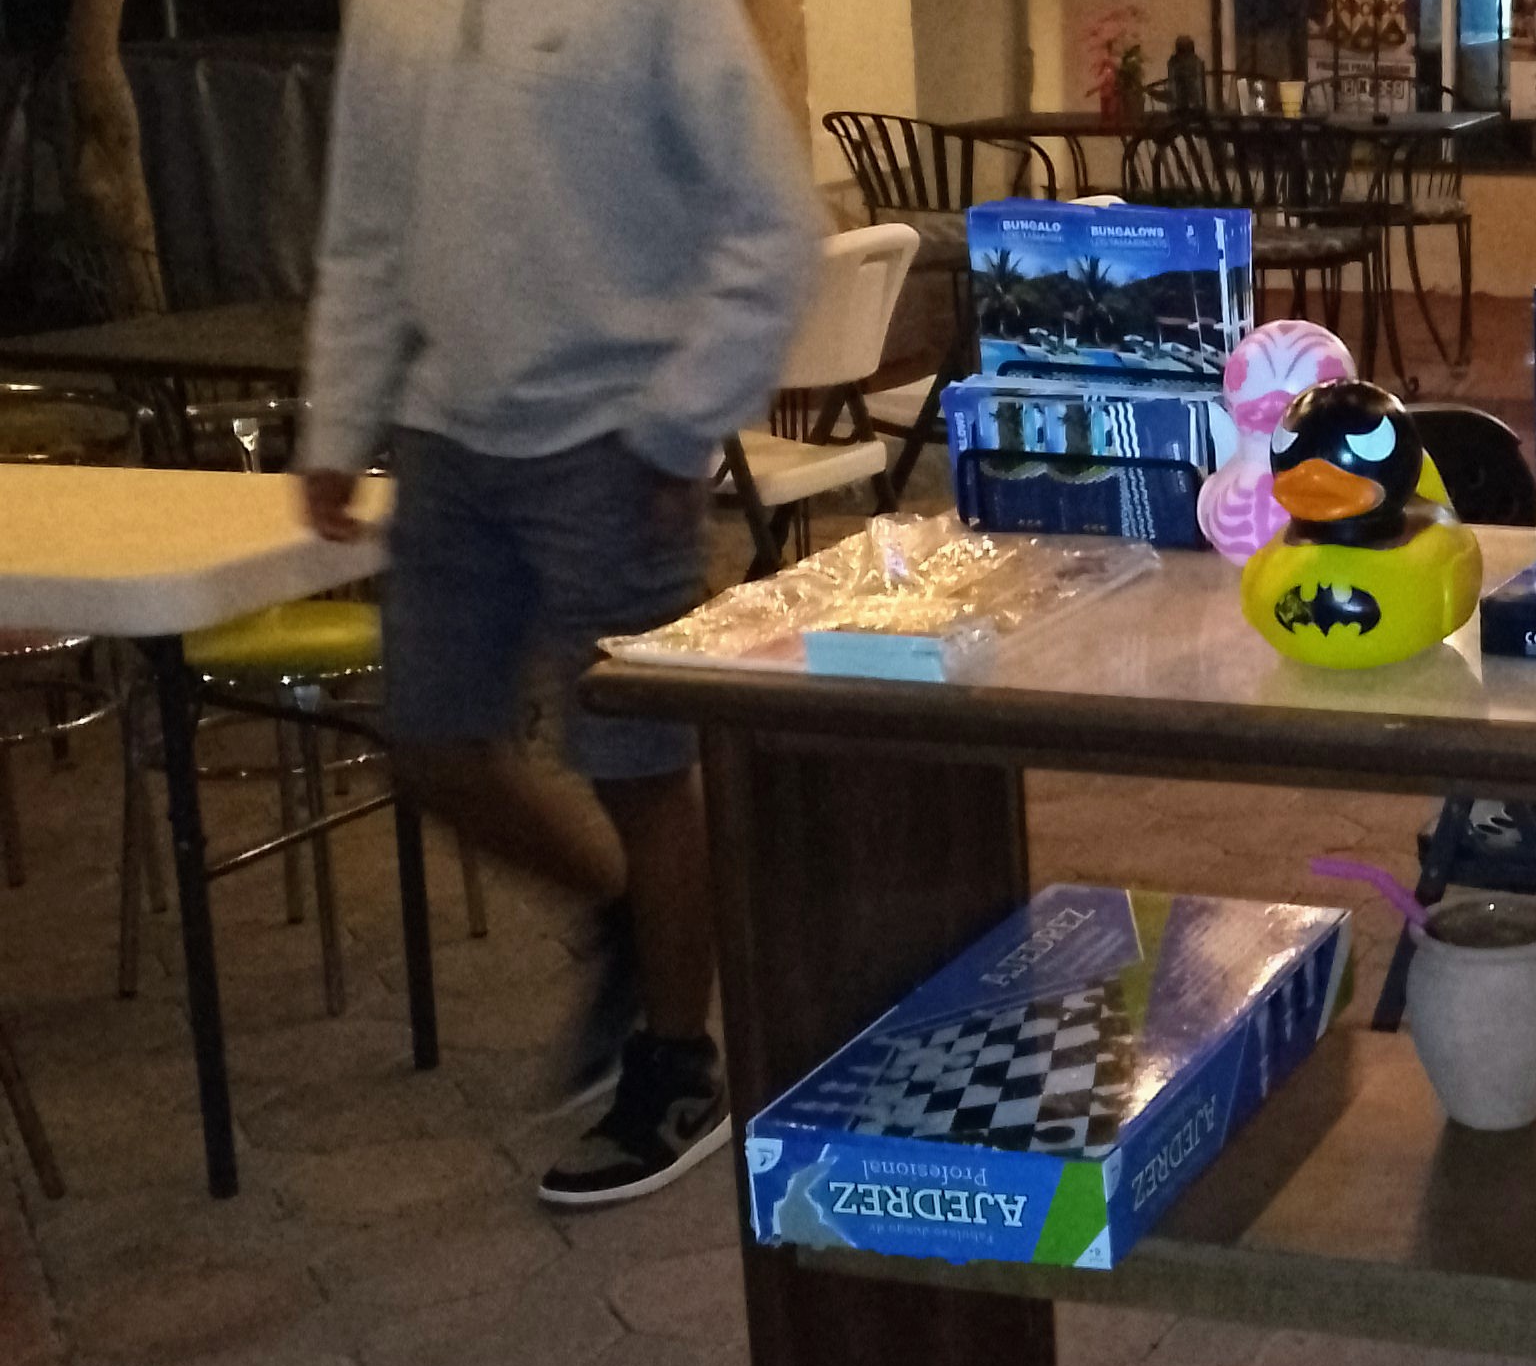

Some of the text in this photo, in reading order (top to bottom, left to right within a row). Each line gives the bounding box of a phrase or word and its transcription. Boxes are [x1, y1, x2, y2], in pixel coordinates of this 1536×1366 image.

[1091, 226, 1165, 238] BUNGALOWS
[1131, 1093, 1217, 1212] AJEDREZ
[862, 1159, 988, 1186] Profesional
[828, 1181, 1028, 1228] AJEDREZ
